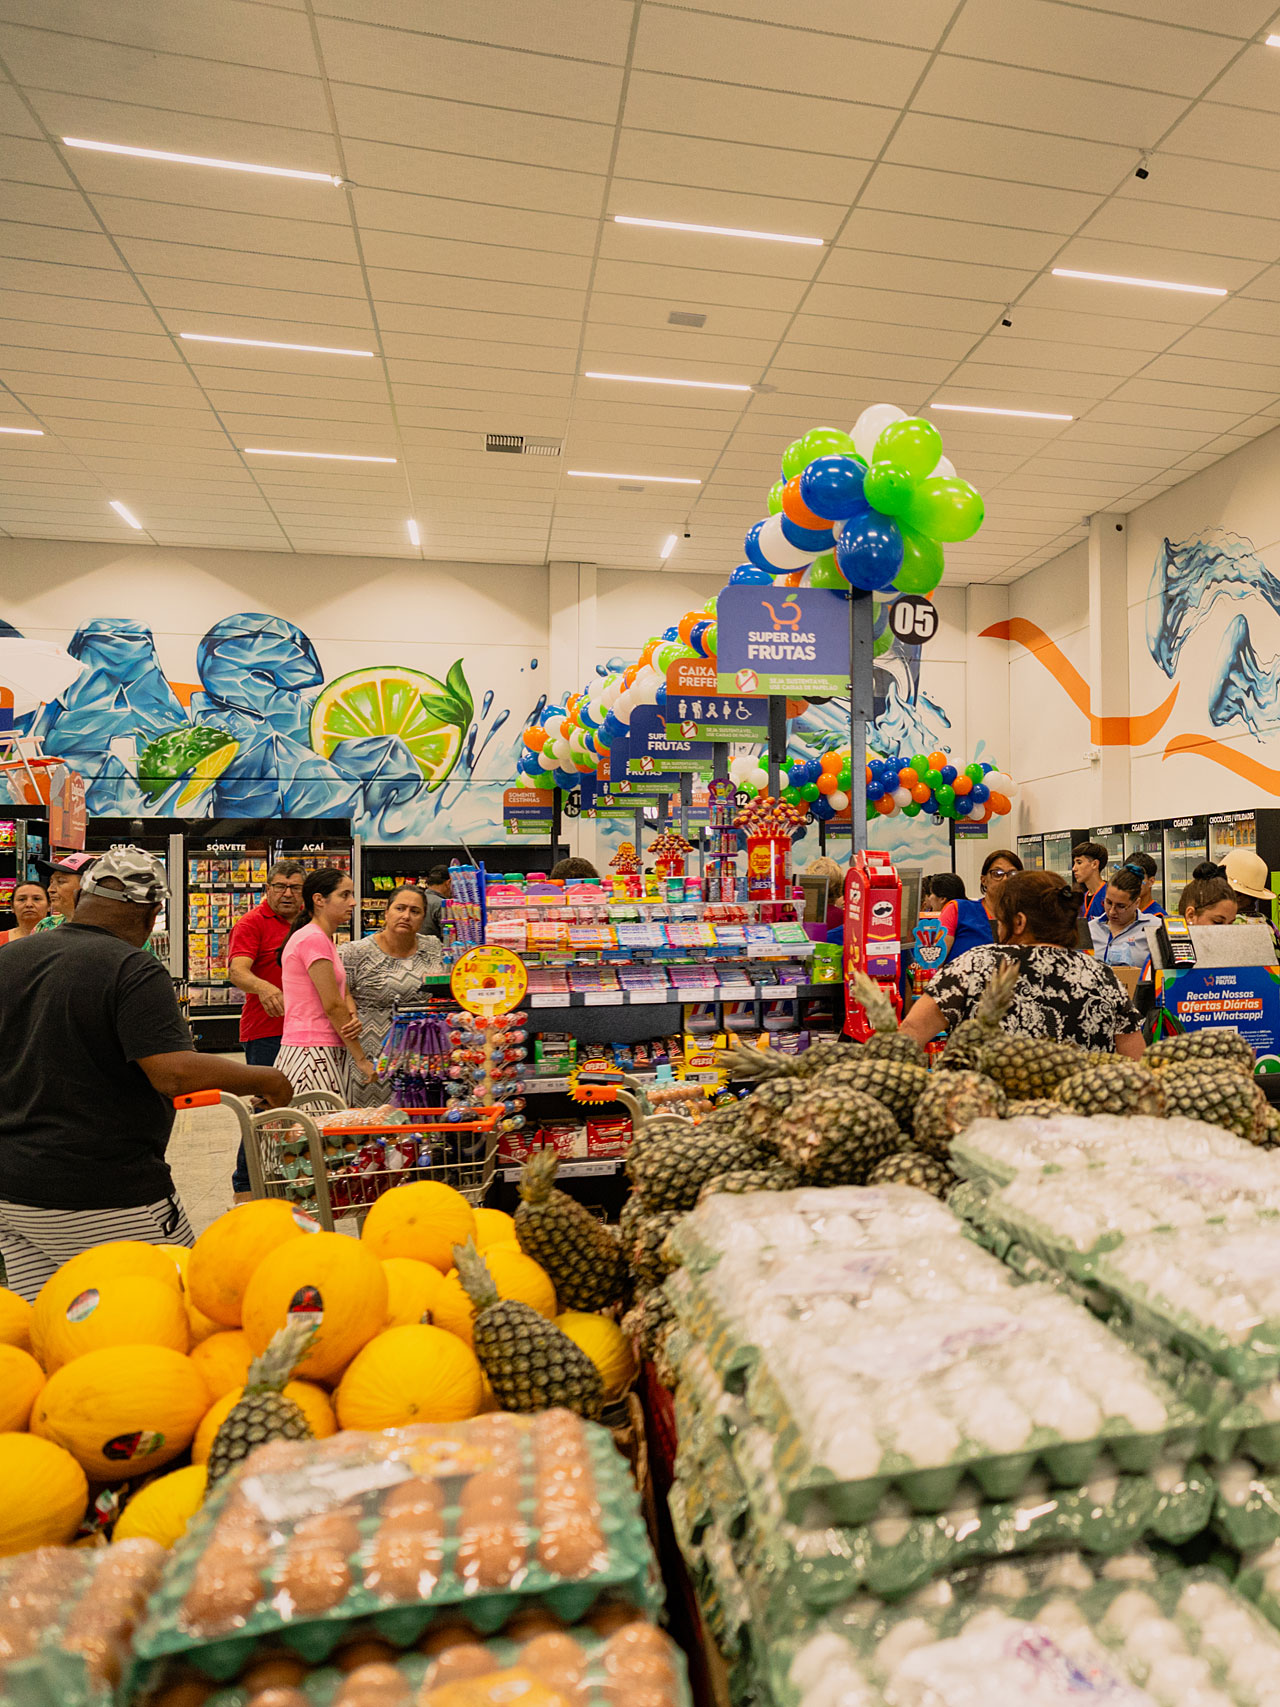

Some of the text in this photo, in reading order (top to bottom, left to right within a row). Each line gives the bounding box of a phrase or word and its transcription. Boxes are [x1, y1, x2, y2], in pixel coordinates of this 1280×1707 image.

[893, 601, 934, 638] 05
[748, 631, 816, 644] SUPER DAS
[748, 645, 817, 661] FRUTAS
[678, 665, 715, 677] CAIXA
[647, 741, 691, 751] FRUTAS
[735, 793, 748, 806] 12
[1173, 818, 1193, 828] CIGARROS
[1209, 814, 1231, 824] CHOCOLATES
[1235, 812, 1255, 822] UTILIDADES
[1096, 827, 1113, 836] CIGARROS
[1131, 823, 1149, 832] CIGARROS
[206, 843, 247, 851] SORVETE
[302, 842, 324, 852] AÇAÍ
[1186, 990, 1254, 1001] Receba Nossas
[1181, 999, 1259, 1013] Ofertas Diárias
[1178, 1010, 1264, 1022] No Seu Whatsapp!
